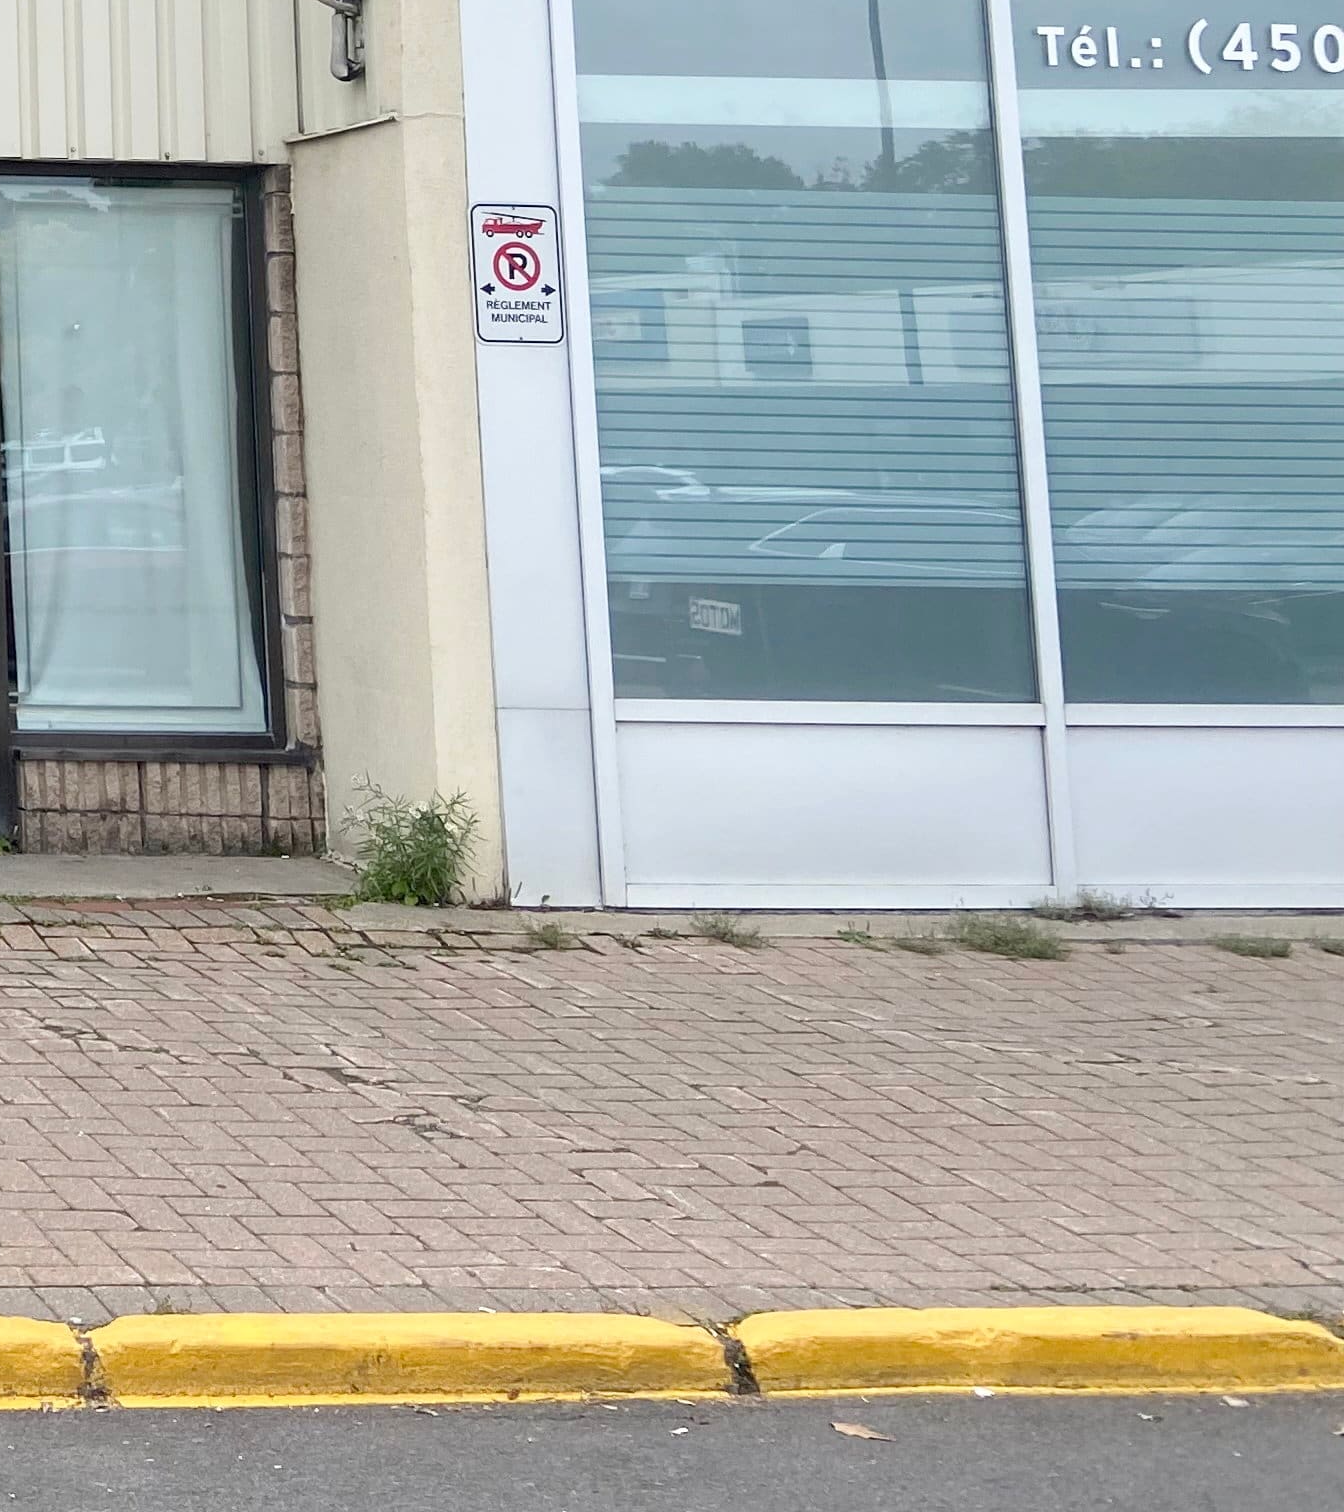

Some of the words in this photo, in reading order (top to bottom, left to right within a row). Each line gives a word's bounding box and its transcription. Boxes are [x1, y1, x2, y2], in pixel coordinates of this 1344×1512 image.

[1036, 24, 1164, 69] Tél.:
[486, 299, 552, 311] RÈGLEMENT
[491, 313, 549, 324] MUNICIPAL
